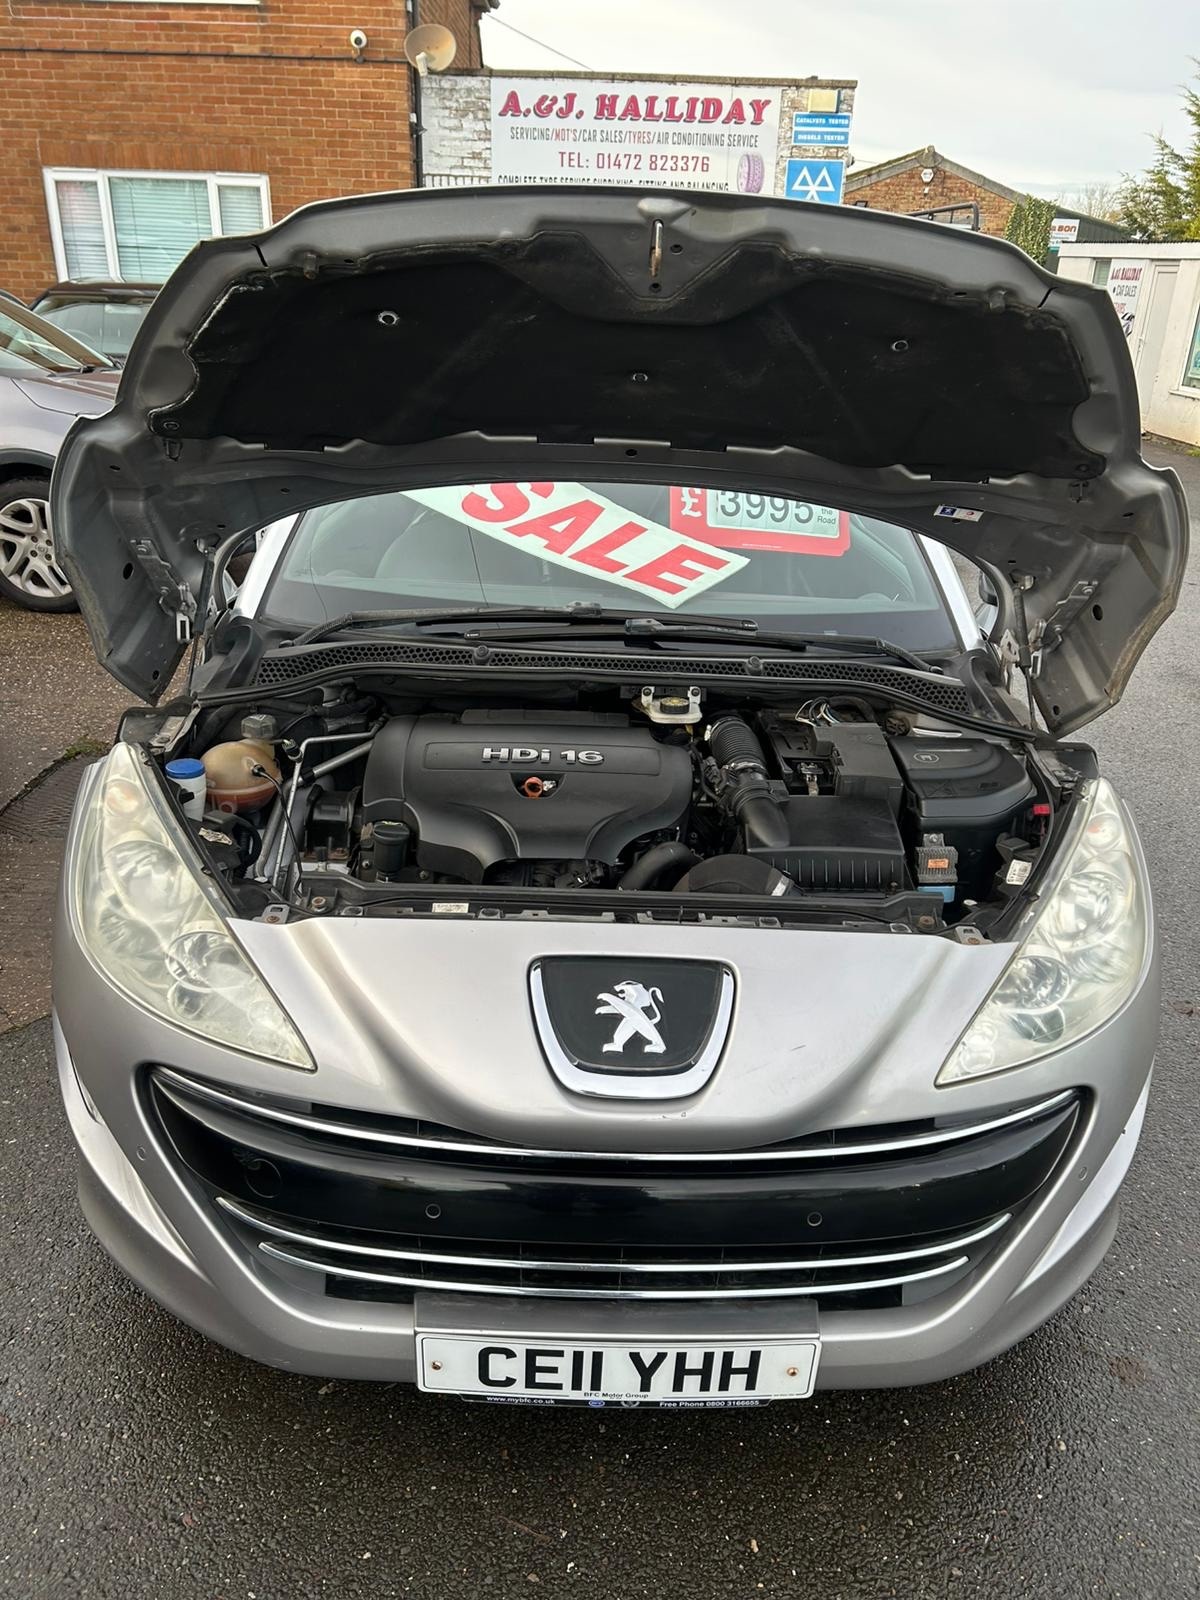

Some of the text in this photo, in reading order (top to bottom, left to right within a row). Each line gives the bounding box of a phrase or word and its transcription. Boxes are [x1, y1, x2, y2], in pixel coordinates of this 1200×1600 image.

[594, 93, 771, 125] HALLIDAY
[672, 132, 725, 147] CONDITIONING
[727, 134, 759, 148] SERVICE
[559, 152, 710, 172] TEL: 01472 823376
[720, 489, 814, 524] 3995
[817, 515, 837, 525] Road
[461, 482, 730, 595] SALE
[482, 747, 605, 765] HDi 16
[628, 1350, 762, 1392] YHH
